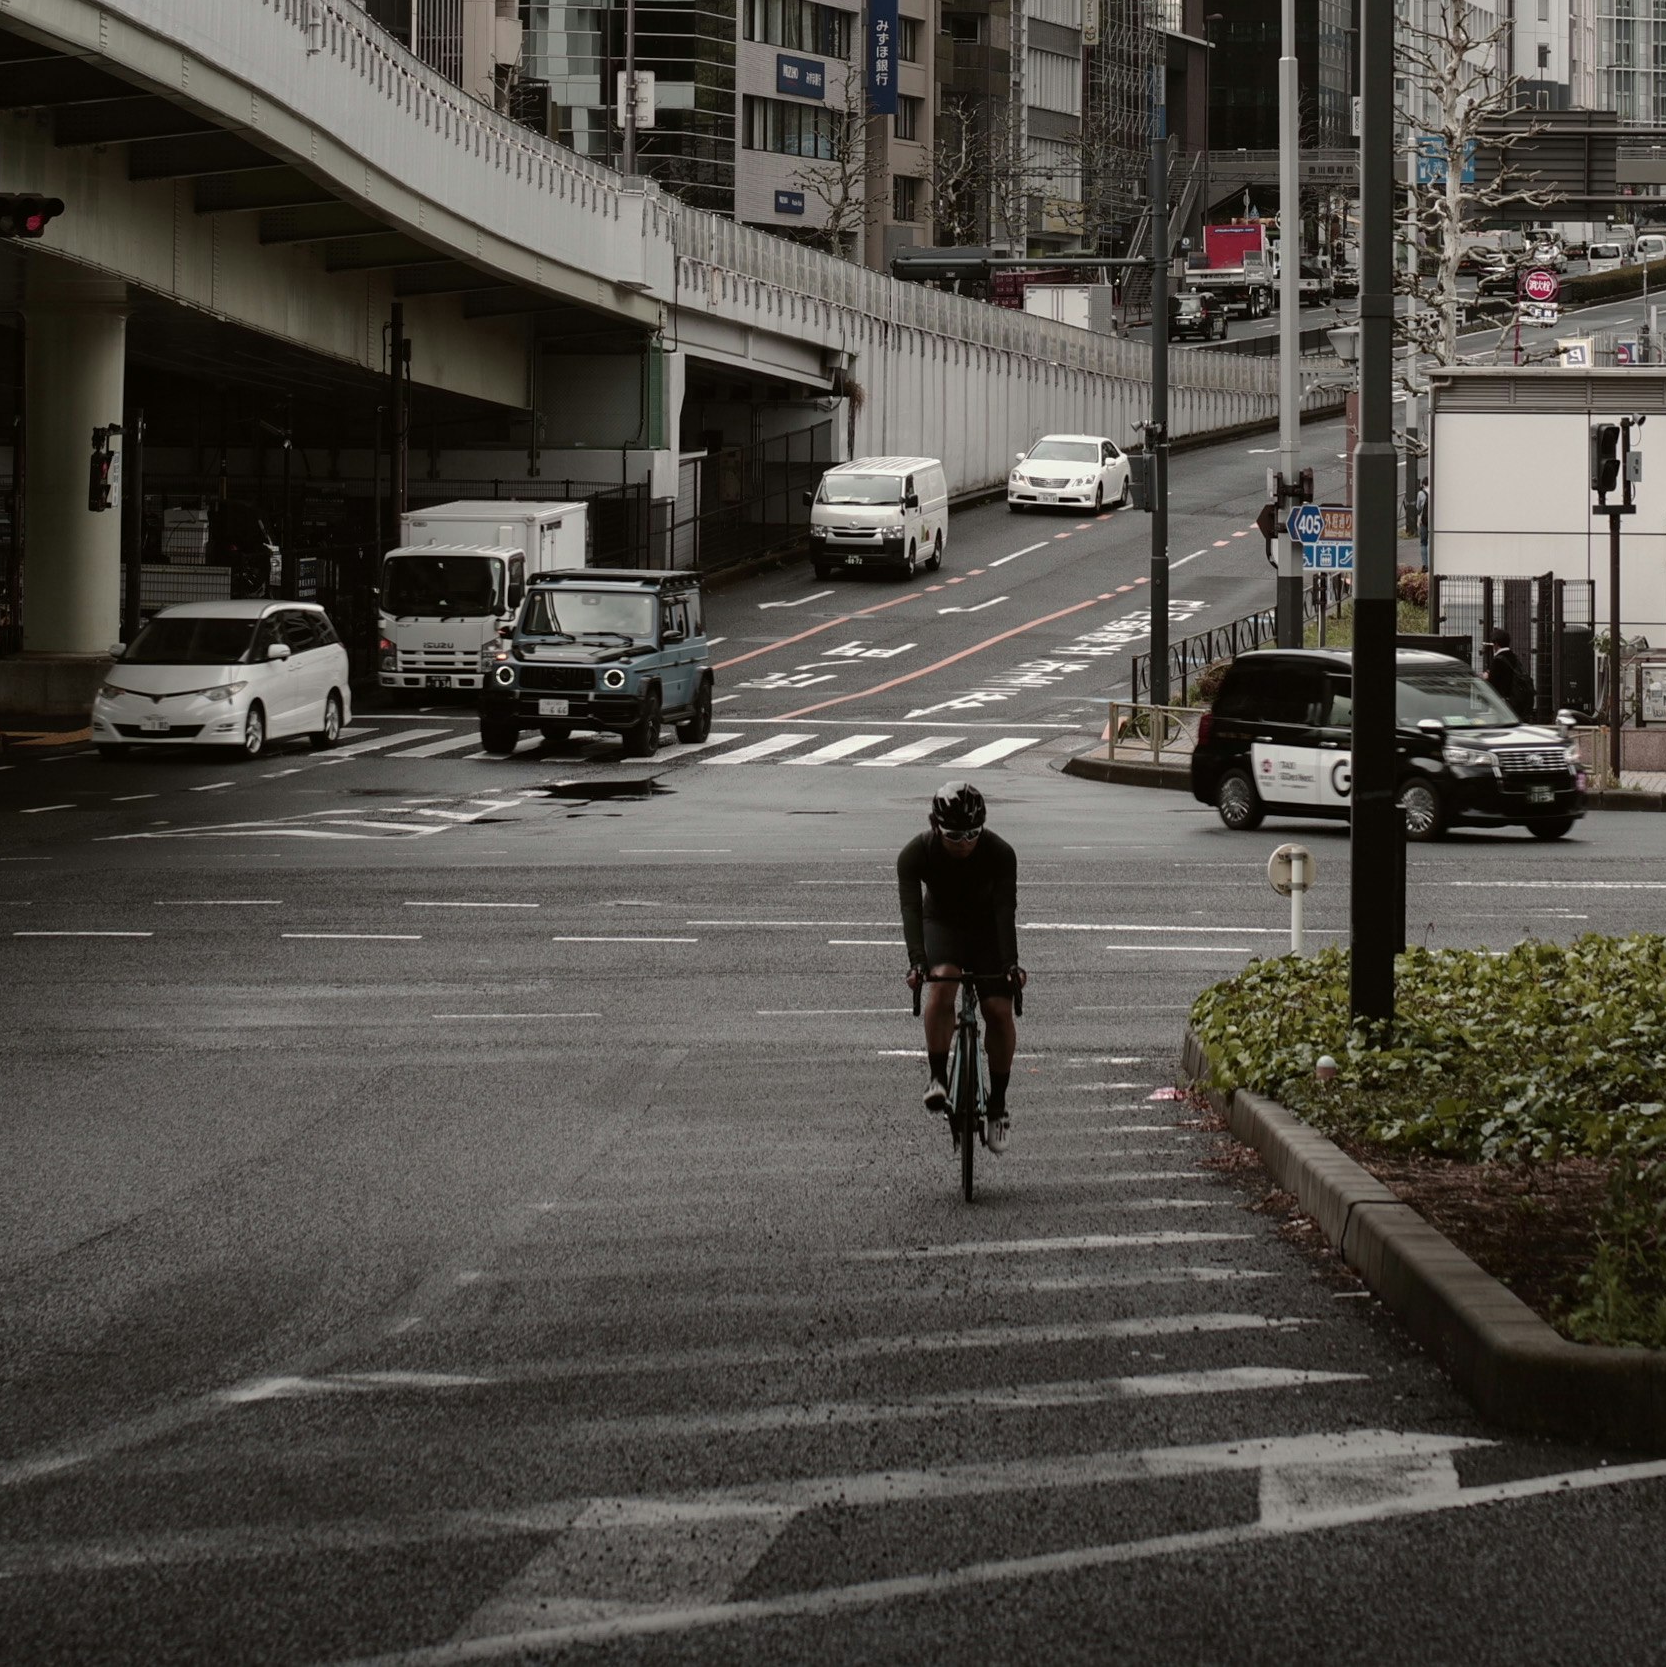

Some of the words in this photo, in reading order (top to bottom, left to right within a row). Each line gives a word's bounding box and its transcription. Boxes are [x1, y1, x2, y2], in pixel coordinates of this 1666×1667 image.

[875, 19, 889, 86] みずほ銀行
[1298, 514, 1321, 535] 405
